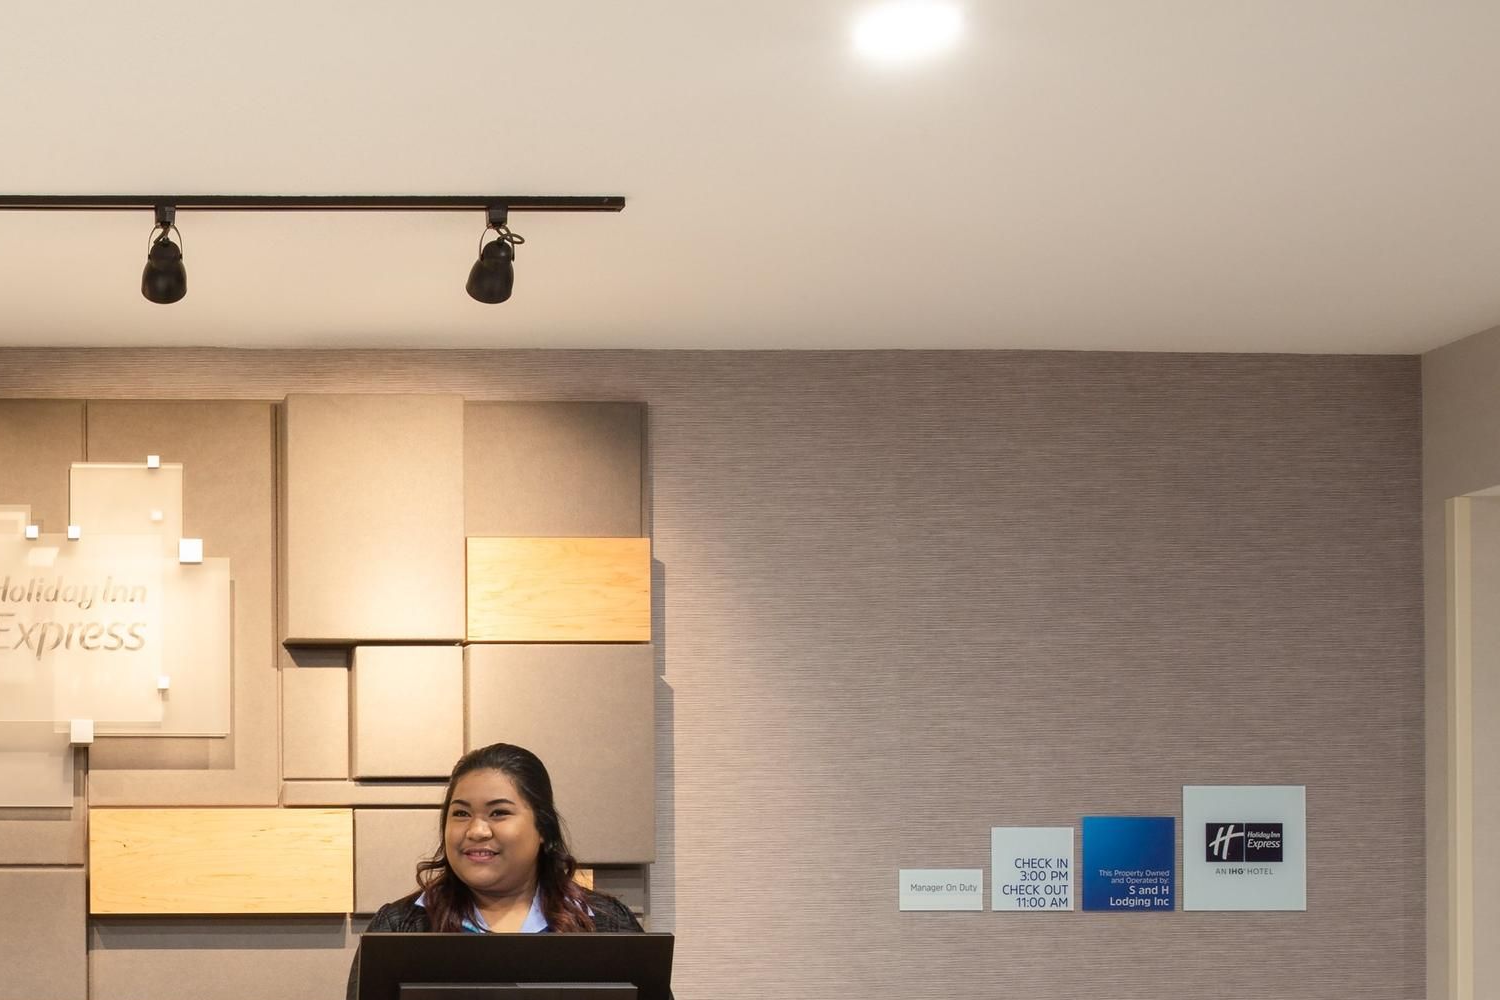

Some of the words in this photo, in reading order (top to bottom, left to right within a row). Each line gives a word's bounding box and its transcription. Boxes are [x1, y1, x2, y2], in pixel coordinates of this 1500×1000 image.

[102, 576, 148, 602] Inn
[1247, 831, 1270, 839] Holiday
[1247, 839, 1281, 850] Express
[1014, 858, 1053, 869] CHECK
[1056, 858, 1068, 869] IN
[1020, 871, 1047, 881] 3:00
[1050, 871, 1068, 881] PM
[1099, 869, 1113, 877] This
[1114, 869, 1144, 877] Property
[1145, 869, 1170, 877] Owned
[1126, 877, 1158, 885] Operated
[910, 883, 943, 893] Manager
[946, 883, 957, 892] On
[959, 883, 978, 892] Duty
[1002, 884, 1040, 895] CHECK
[1044, 884, 1068, 895] OUT
[1129, 885, 1136, 895] S
[1138, 885, 1158, 895] and
[1161, 885, 1169, 895] H
[1016, 897, 1046, 907] 11:00
[1050, 897, 1068, 907] AM
[1109, 896, 1151, 907] Lodging
[1154, 896, 1169, 906] Inc
